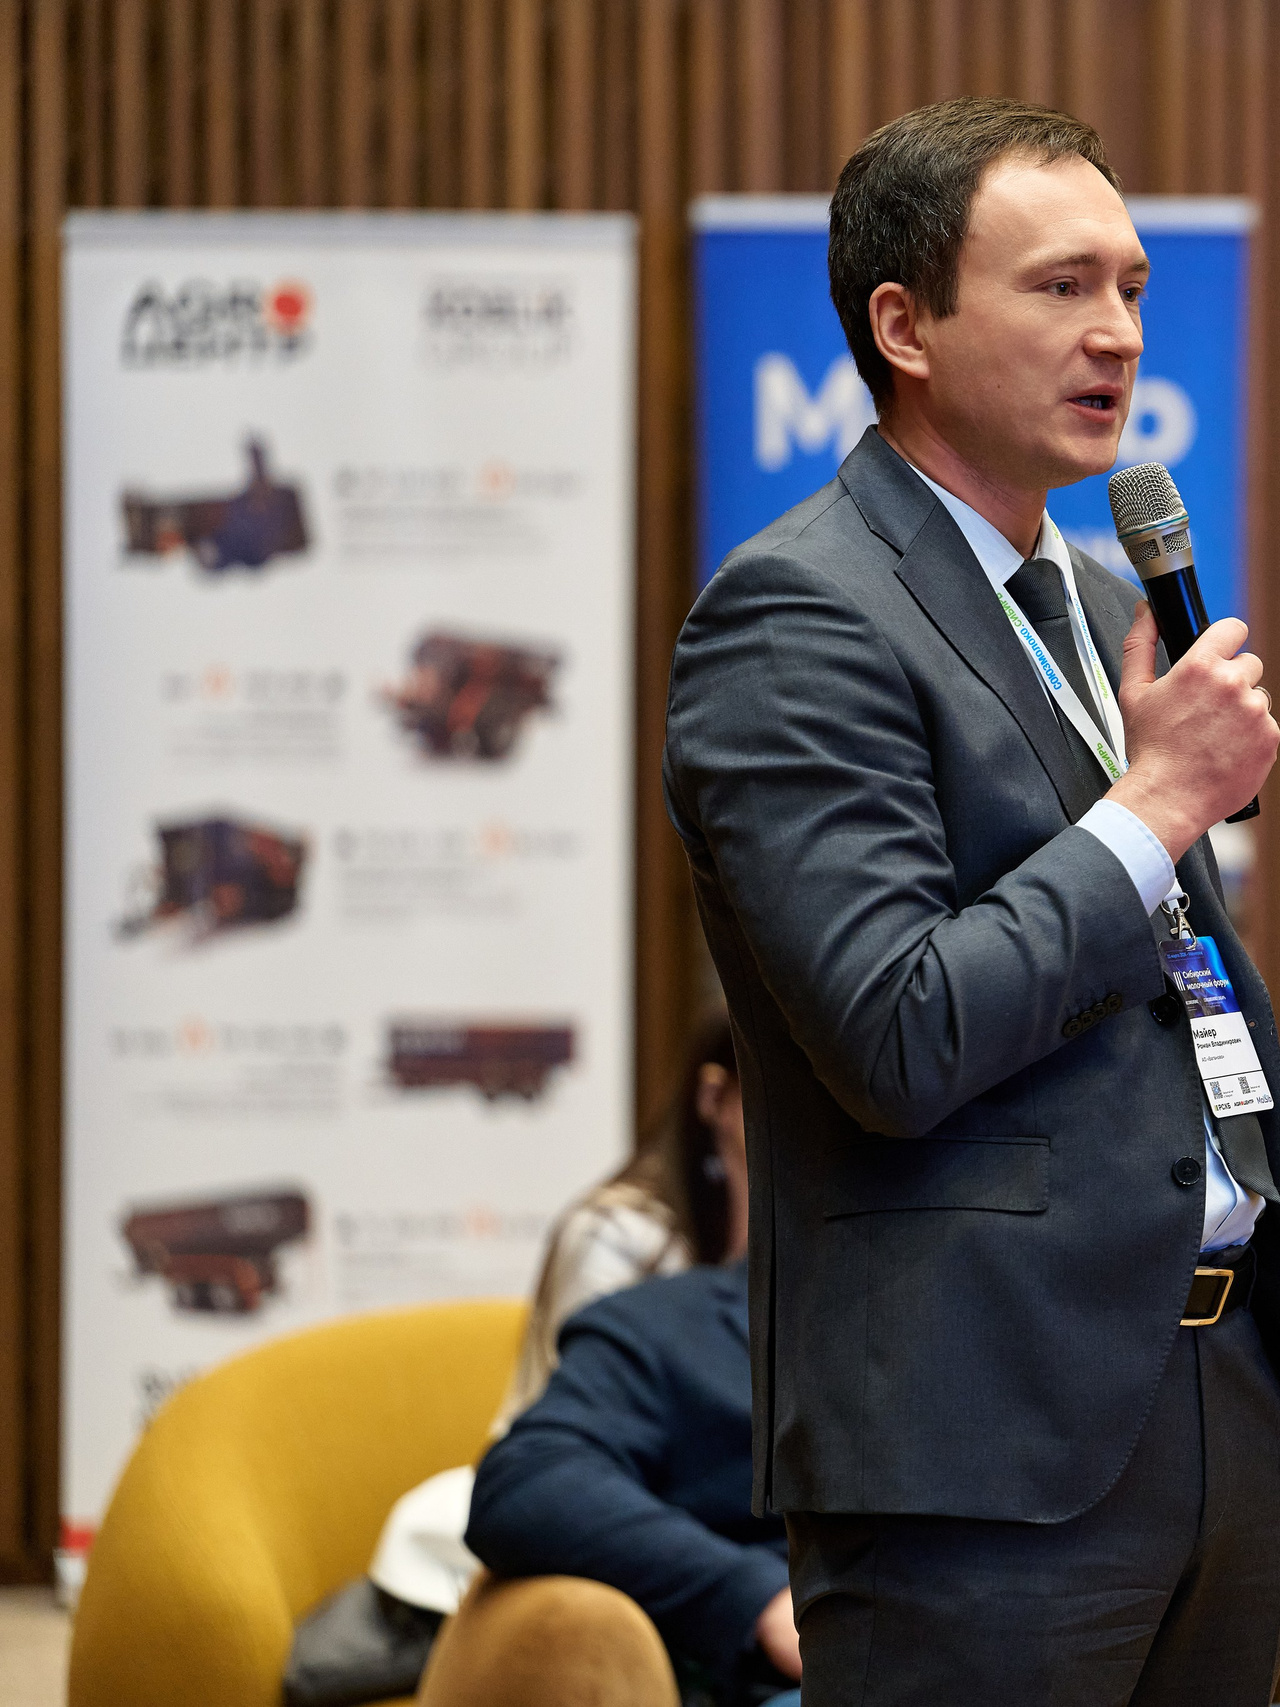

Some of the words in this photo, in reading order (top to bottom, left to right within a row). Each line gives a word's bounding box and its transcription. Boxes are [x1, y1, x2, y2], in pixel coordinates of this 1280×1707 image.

[1182, 967, 1212, 979] Сибирский
[1186, 979, 1213, 991] молочный
[1213, 978, 1230, 989] форум
[1192, 1027, 1217, 1040] Майер
